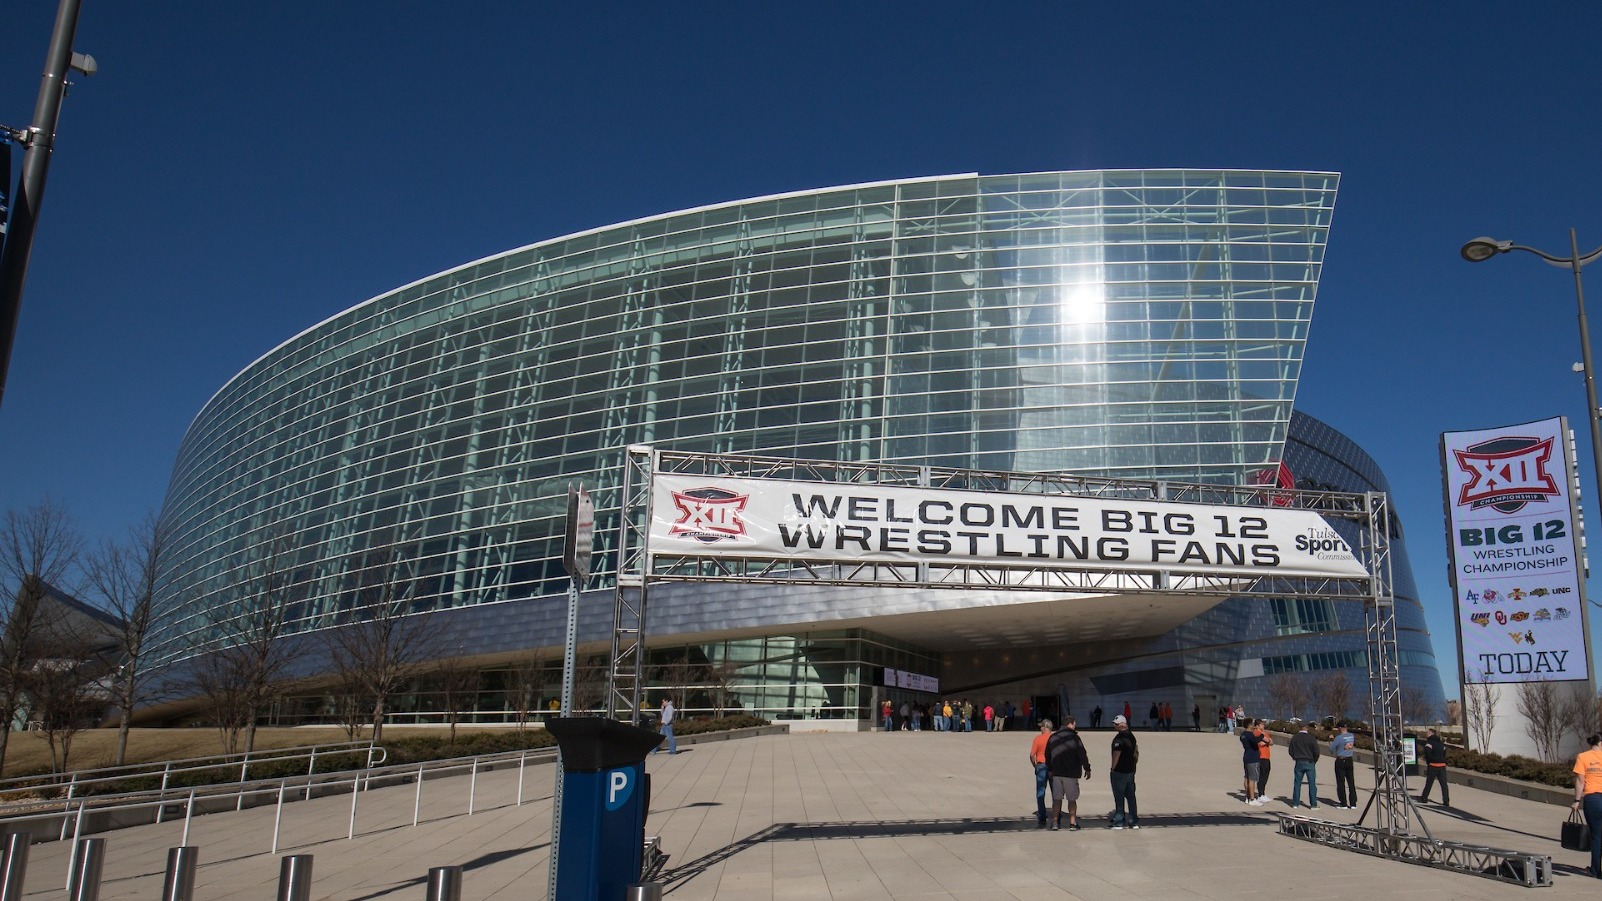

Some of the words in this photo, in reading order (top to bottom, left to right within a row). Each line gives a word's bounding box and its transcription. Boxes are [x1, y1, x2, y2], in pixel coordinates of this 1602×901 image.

[1479, 494, 1538, 505] CHAMPIONSHIP
[792, 493, 1080, 531] WELCOME
[1101, 509, 1195, 536] BIG
[1214, 515, 1269, 540] 12
[1460, 525, 1523, 546] BIG
[1533, 520, 1566, 541] 12
[778, 524, 1129, 562] WRESTLING
[1151, 539, 1281, 568] FANS
[1474, 544, 1555, 559] WRESTLING
[1463, 556, 1568, 574] CHAMPIONSHIP
[1552, 587, 1571, 595] UNC
[1479, 650, 1569, 675] TODAY
[610, 771, 628, 803] P
